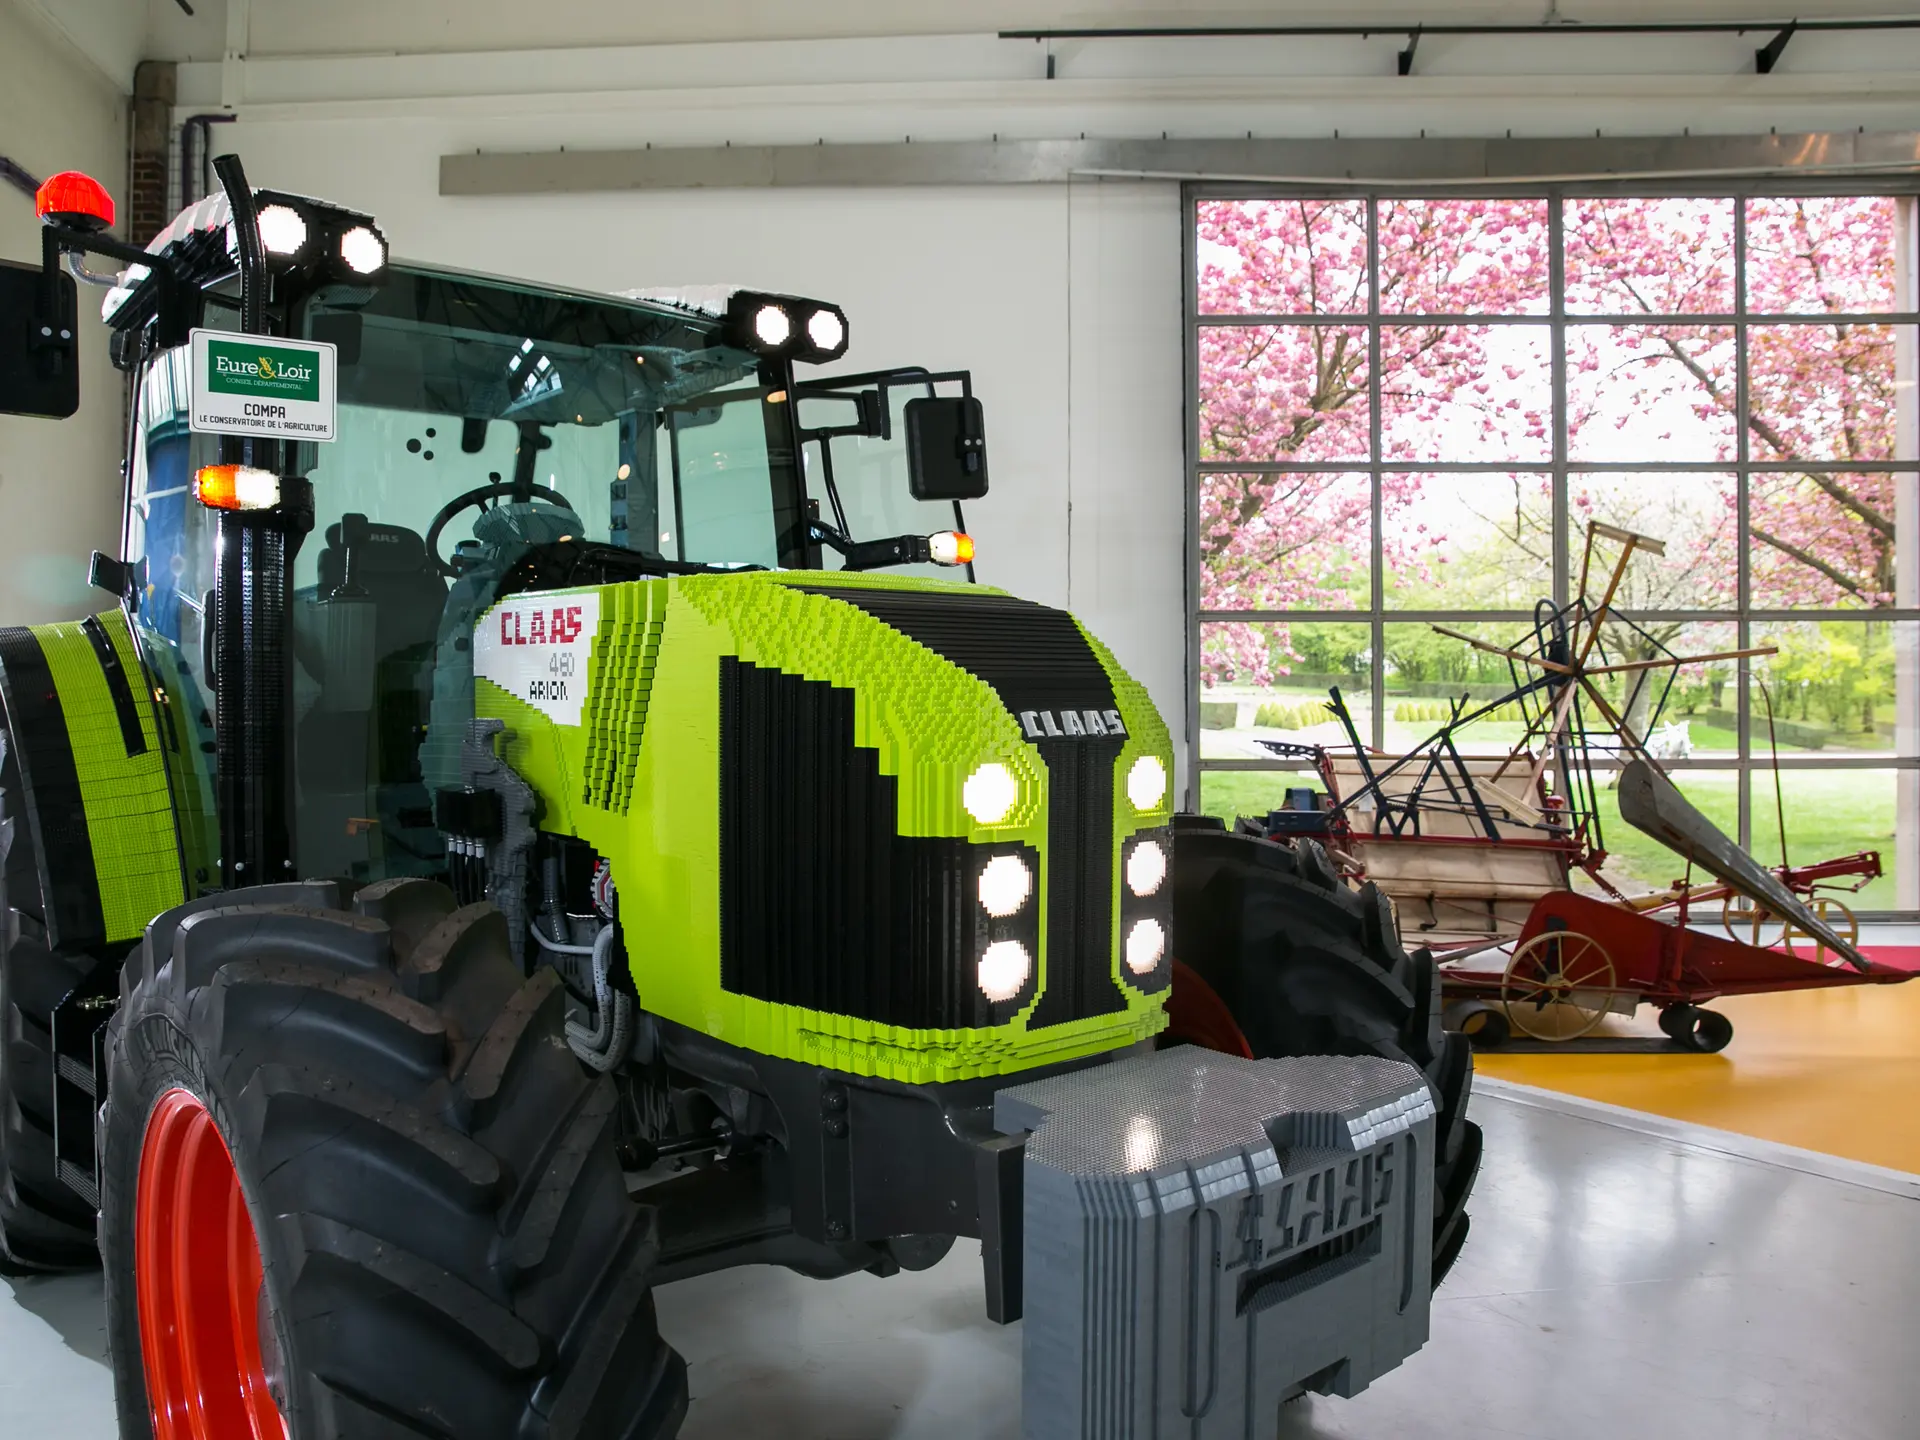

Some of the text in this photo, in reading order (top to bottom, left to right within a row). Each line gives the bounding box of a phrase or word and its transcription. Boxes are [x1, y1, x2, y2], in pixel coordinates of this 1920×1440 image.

[226, 377, 253, 386] CONSEIL
[244, 403, 286, 419] COMPA
[199, 414, 328, 433] LE CONSERVATOIRE DE L'AGRICULTURE
[501, 606, 582, 645] CLAAS
[529, 680, 568, 701] ARION
[1020, 709, 1126, 738] CLAAS
